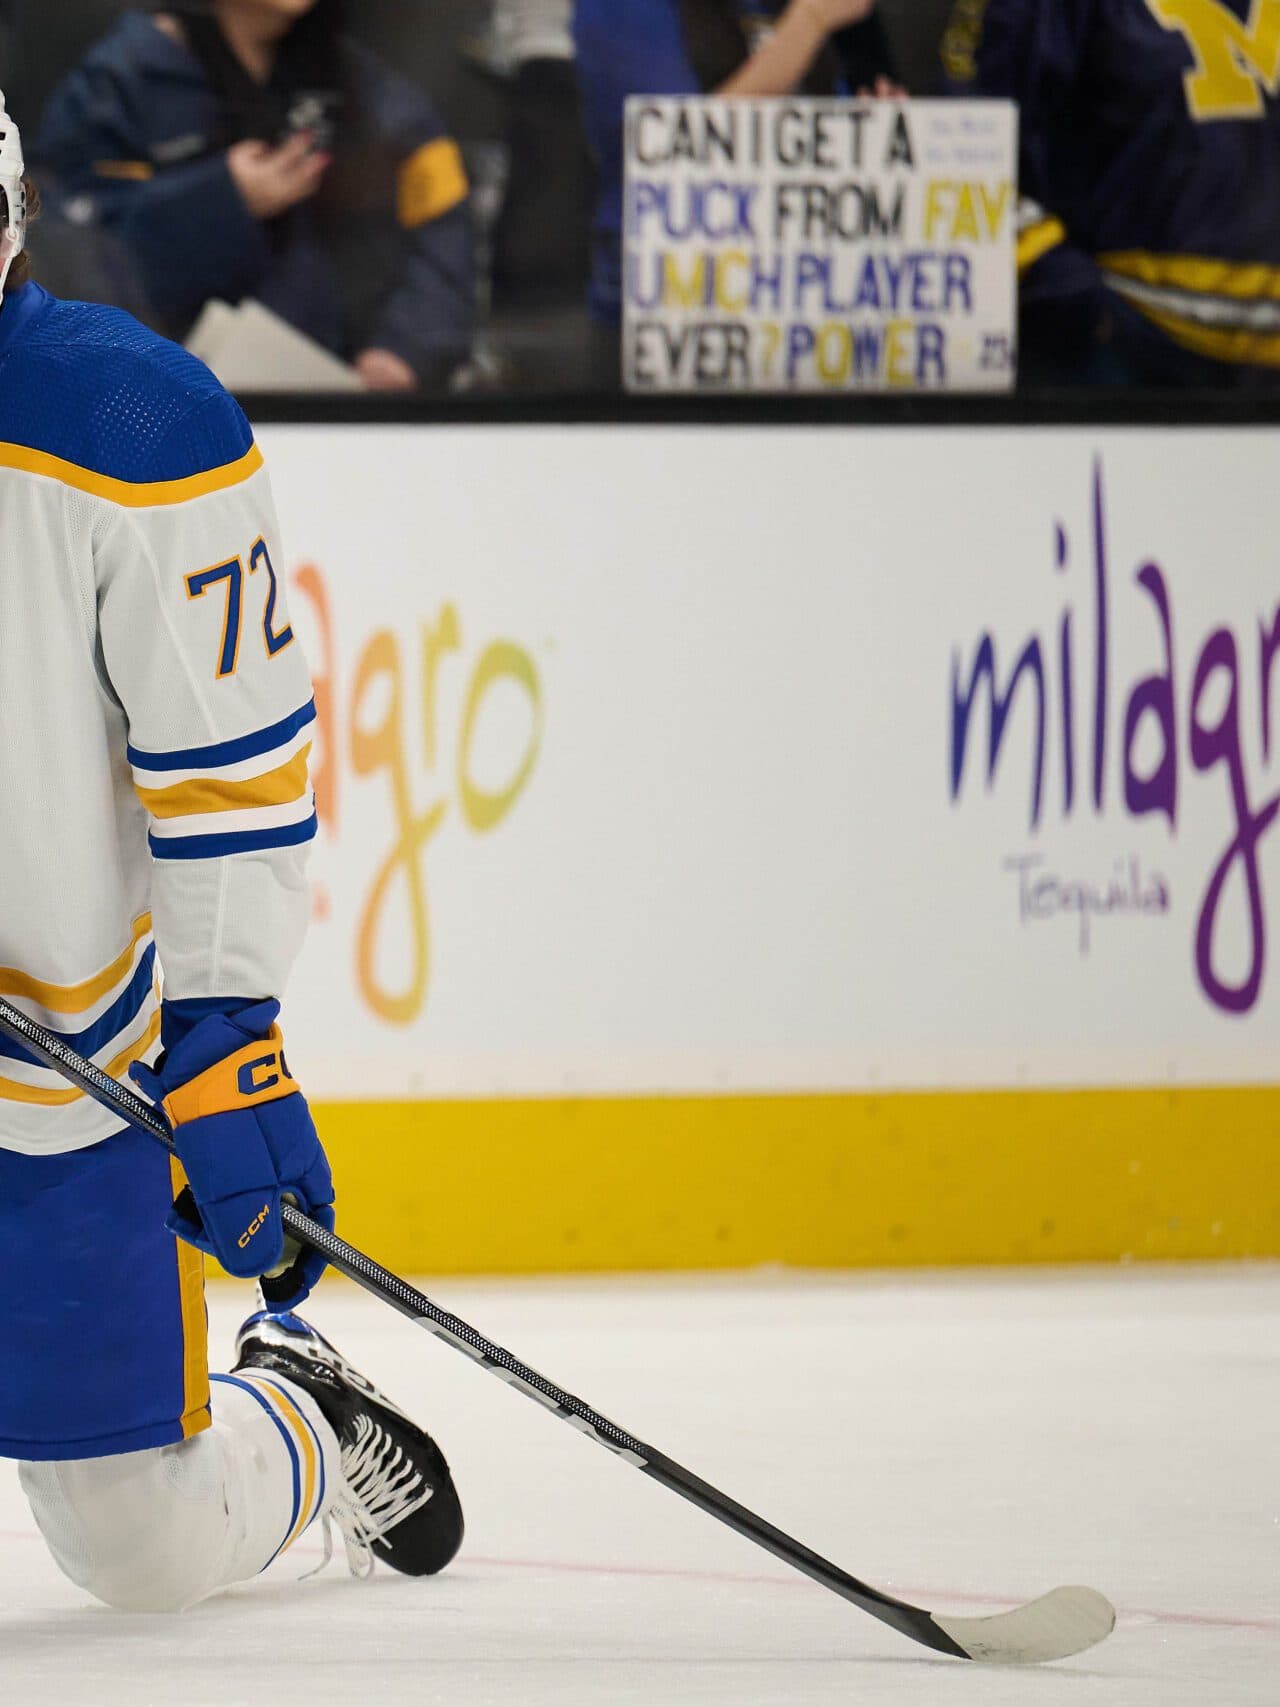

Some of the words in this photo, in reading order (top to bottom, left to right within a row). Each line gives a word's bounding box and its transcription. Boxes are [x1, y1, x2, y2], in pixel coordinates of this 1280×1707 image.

[634, 107, 736, 166] CAN
[750, 109, 764, 165] I
[774, 108, 872, 168] GET
[884, 110, 915, 168] A
[629, 182, 758, 240] PUCK
[773, 183, 906, 240] FROM
[924, 180, 1012, 242] FAV
[627, 252, 784, 313] UMICH
[794, 254, 971, 314] PLAYER
[786, 320, 946, 386] POWER
[183, 535, 296, 680] 72
[1004, 855, 1169, 957] Tequila
[237, 1203, 271, 1249] CCM
